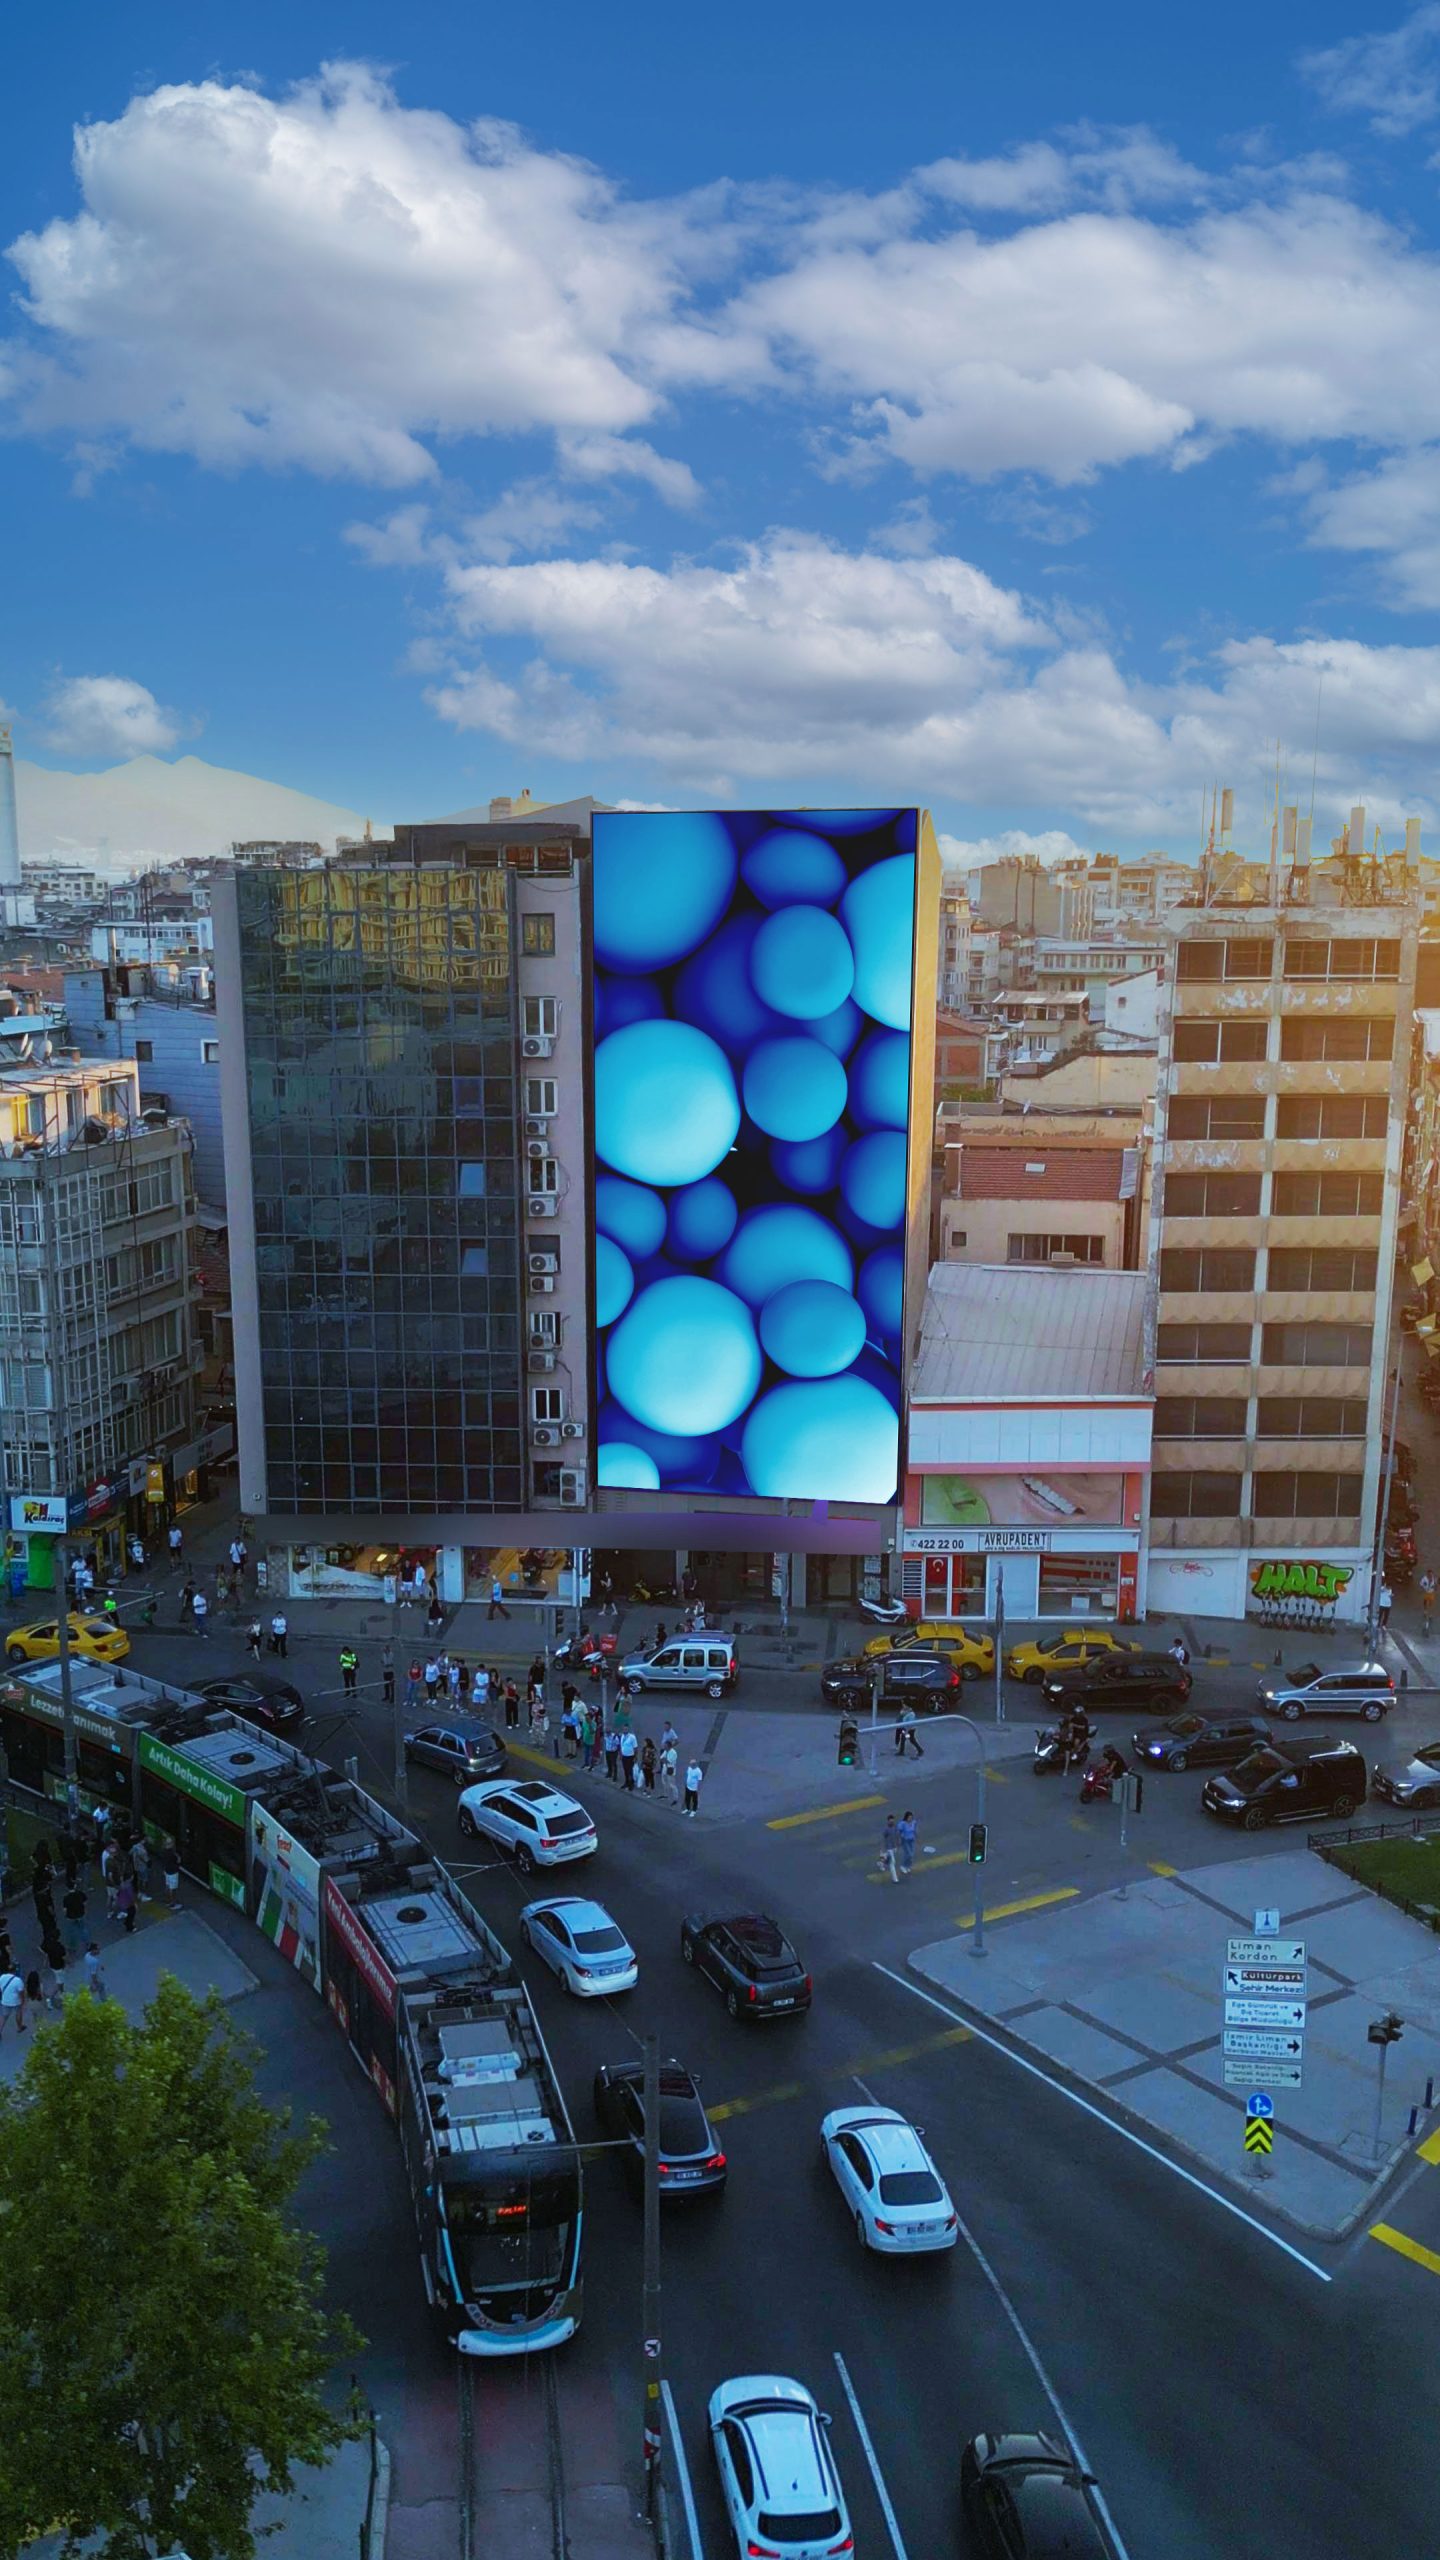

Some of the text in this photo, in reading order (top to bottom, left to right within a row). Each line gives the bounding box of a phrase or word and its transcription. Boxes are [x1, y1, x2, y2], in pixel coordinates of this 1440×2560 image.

[918, 1540, 964, 1549] 422 22 00
[984, 1532, 1047, 1546] AVRUPADENT
[72, 1711, 117, 1741] anımak
[149, 1747, 233, 1810] Artık Daha Kolay!
[1230, 1942, 1271, 1950] Liman
[1230, 1951, 1277, 1960] Kordon
